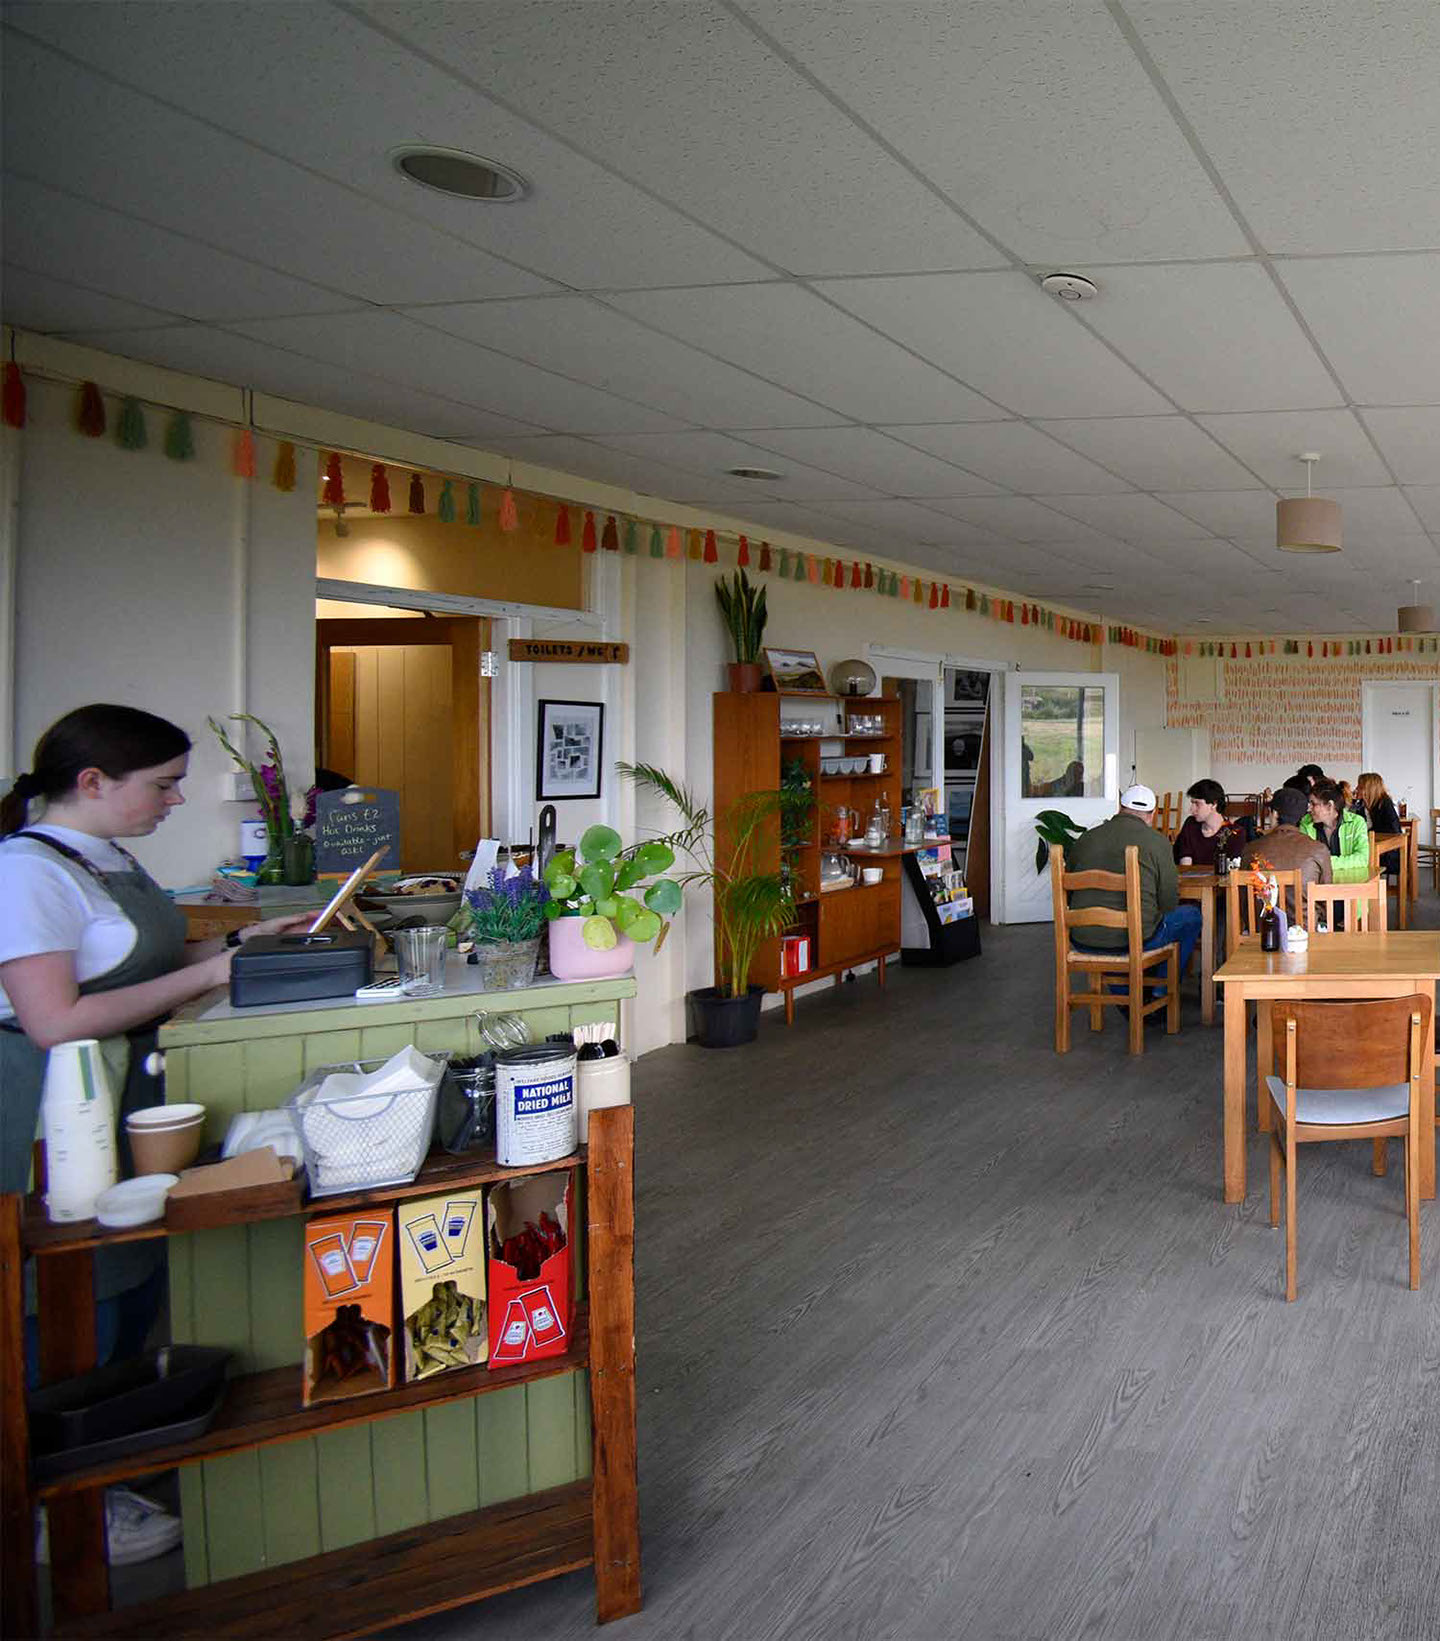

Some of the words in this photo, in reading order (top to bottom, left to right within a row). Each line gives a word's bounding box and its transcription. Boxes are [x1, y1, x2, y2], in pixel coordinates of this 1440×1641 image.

[526, 645, 572, 655] TOILETS
[522, 1081, 569, 1098] NATIONAL
[517, 1098, 549, 1112] DRIED
[551, 1091, 571, 1106] MILK
